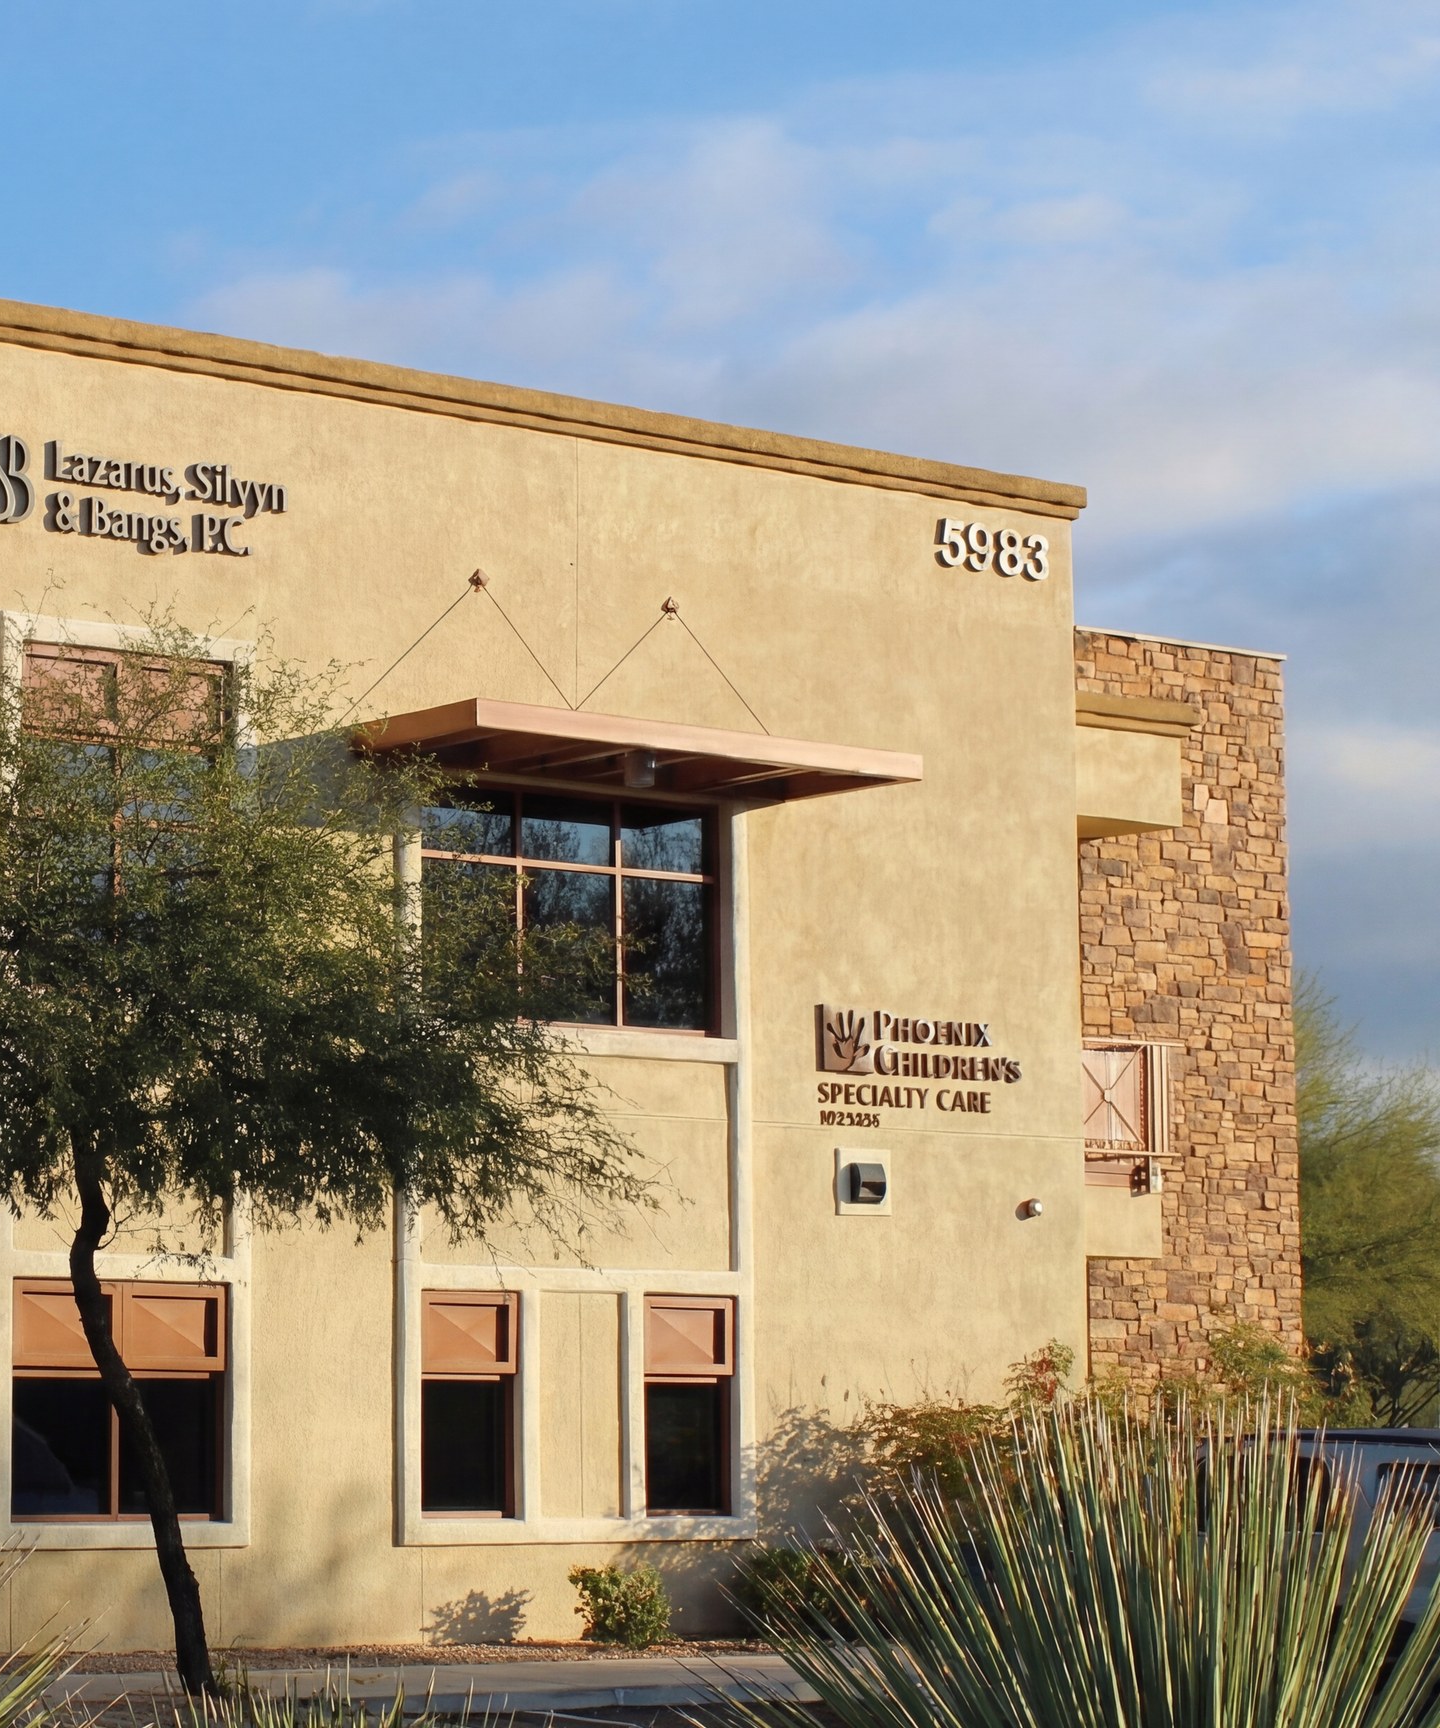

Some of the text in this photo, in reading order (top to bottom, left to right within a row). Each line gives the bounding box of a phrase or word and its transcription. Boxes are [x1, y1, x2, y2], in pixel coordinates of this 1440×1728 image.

[47, 440, 288, 517] Lazarus, Silvyn
[48, 490, 253, 555] & Bangs, P.C.
[935, 518, 1050, 582] 5983
[873, 1010, 993, 1047] PHOENIX
[817, 1082, 991, 1114] SPECIALTY CARE
